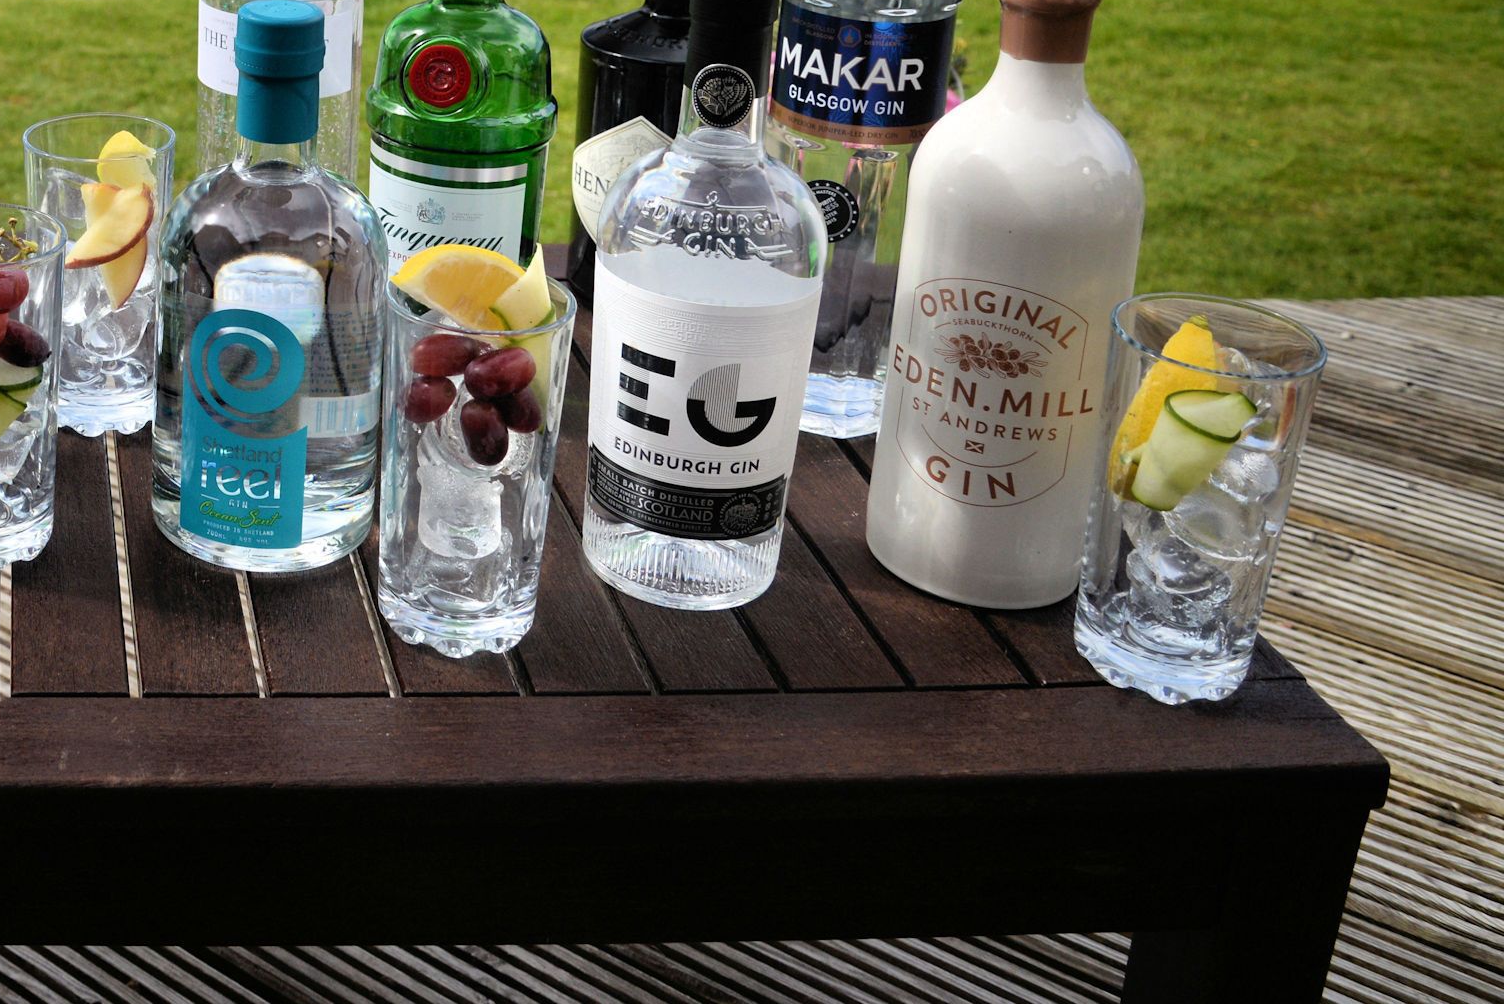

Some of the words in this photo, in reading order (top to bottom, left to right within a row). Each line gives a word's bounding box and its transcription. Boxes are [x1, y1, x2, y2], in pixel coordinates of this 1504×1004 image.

[204, 27, 228, 49] THE
[780, 36, 925, 92] MAKAR
[788, 84, 870, 114] GLASGOW
[874, 101, 905, 116] GIN
[575, 162, 609, 196] HEN
[378, 207, 504, 252] Tanqueray
[640, 198, 785, 236] EDINBURGH
[388, 250, 412, 262] EXPO
[683, 232, 736, 259] GIN
[920, 288, 1077, 350] ORIGINAL
[952, 318, 1034, 342] SEABUCKTHORN
[617, 342, 777, 448] EG
[939, 411, 1057, 442] ANDREWS
[202, 436, 282, 463] Shetland
[615, 436, 722, 475] EDINBURGH
[730, 459, 760, 475] GIN
[201, 459, 281, 499] reel
[597, 462, 620, 483] SMALL
[622, 478, 655, 497] BATCH
[659, 491, 715, 507] DISTILLED
[925, 455, 1016, 500] GIN
[199, 501, 239, 524] Ocean
[229, 499, 248, 509] GIN
[637, 497, 714, 522] SCOTLAND
